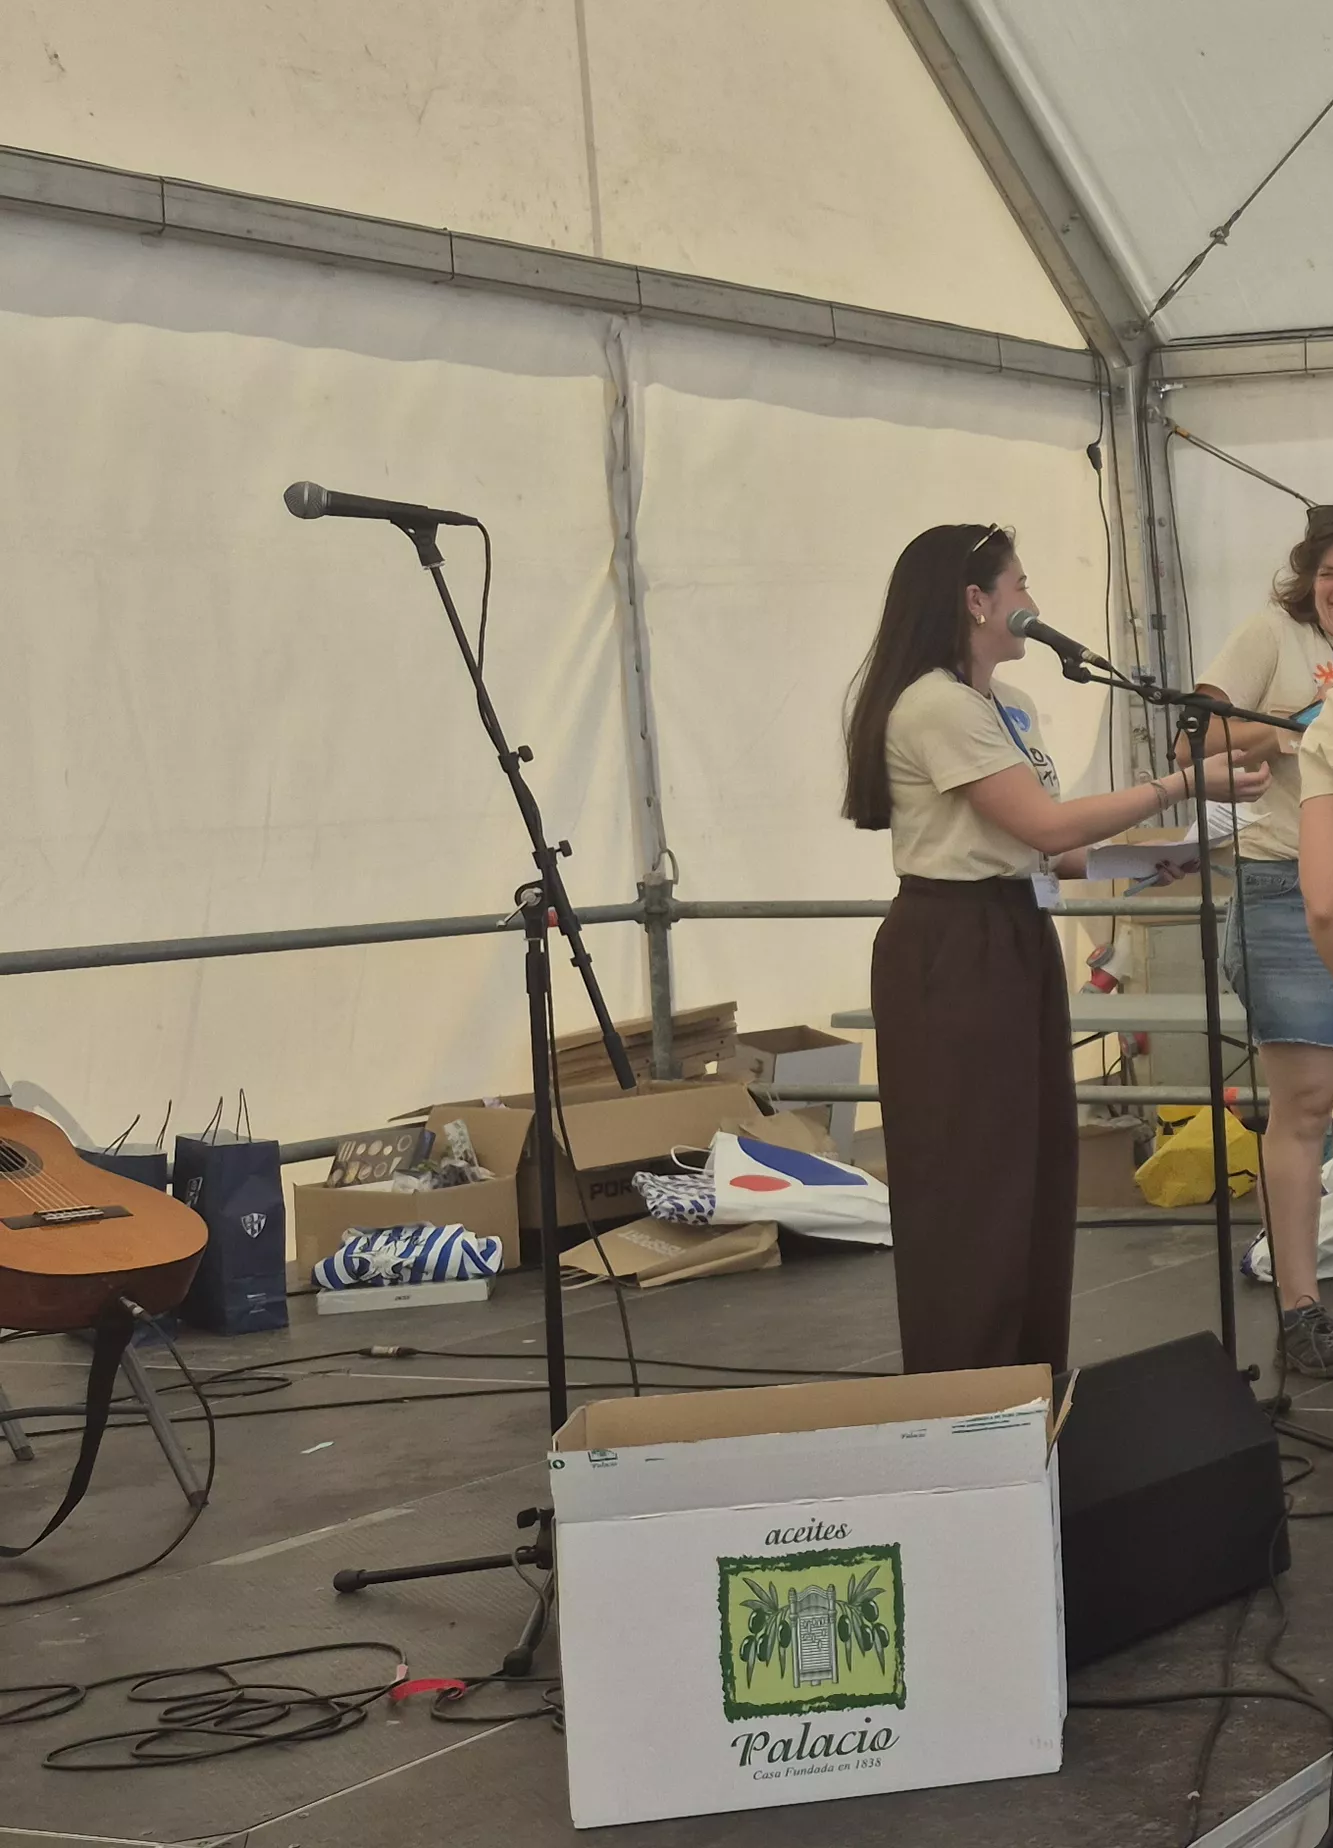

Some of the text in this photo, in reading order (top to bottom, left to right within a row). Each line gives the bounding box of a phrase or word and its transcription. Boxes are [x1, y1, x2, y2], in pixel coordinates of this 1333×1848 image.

[765, 1517, 852, 1546] aceites
[731, 1716, 900, 1767] Palacio
[753, 1757, 882, 1781] Casa Fundada en 1838
